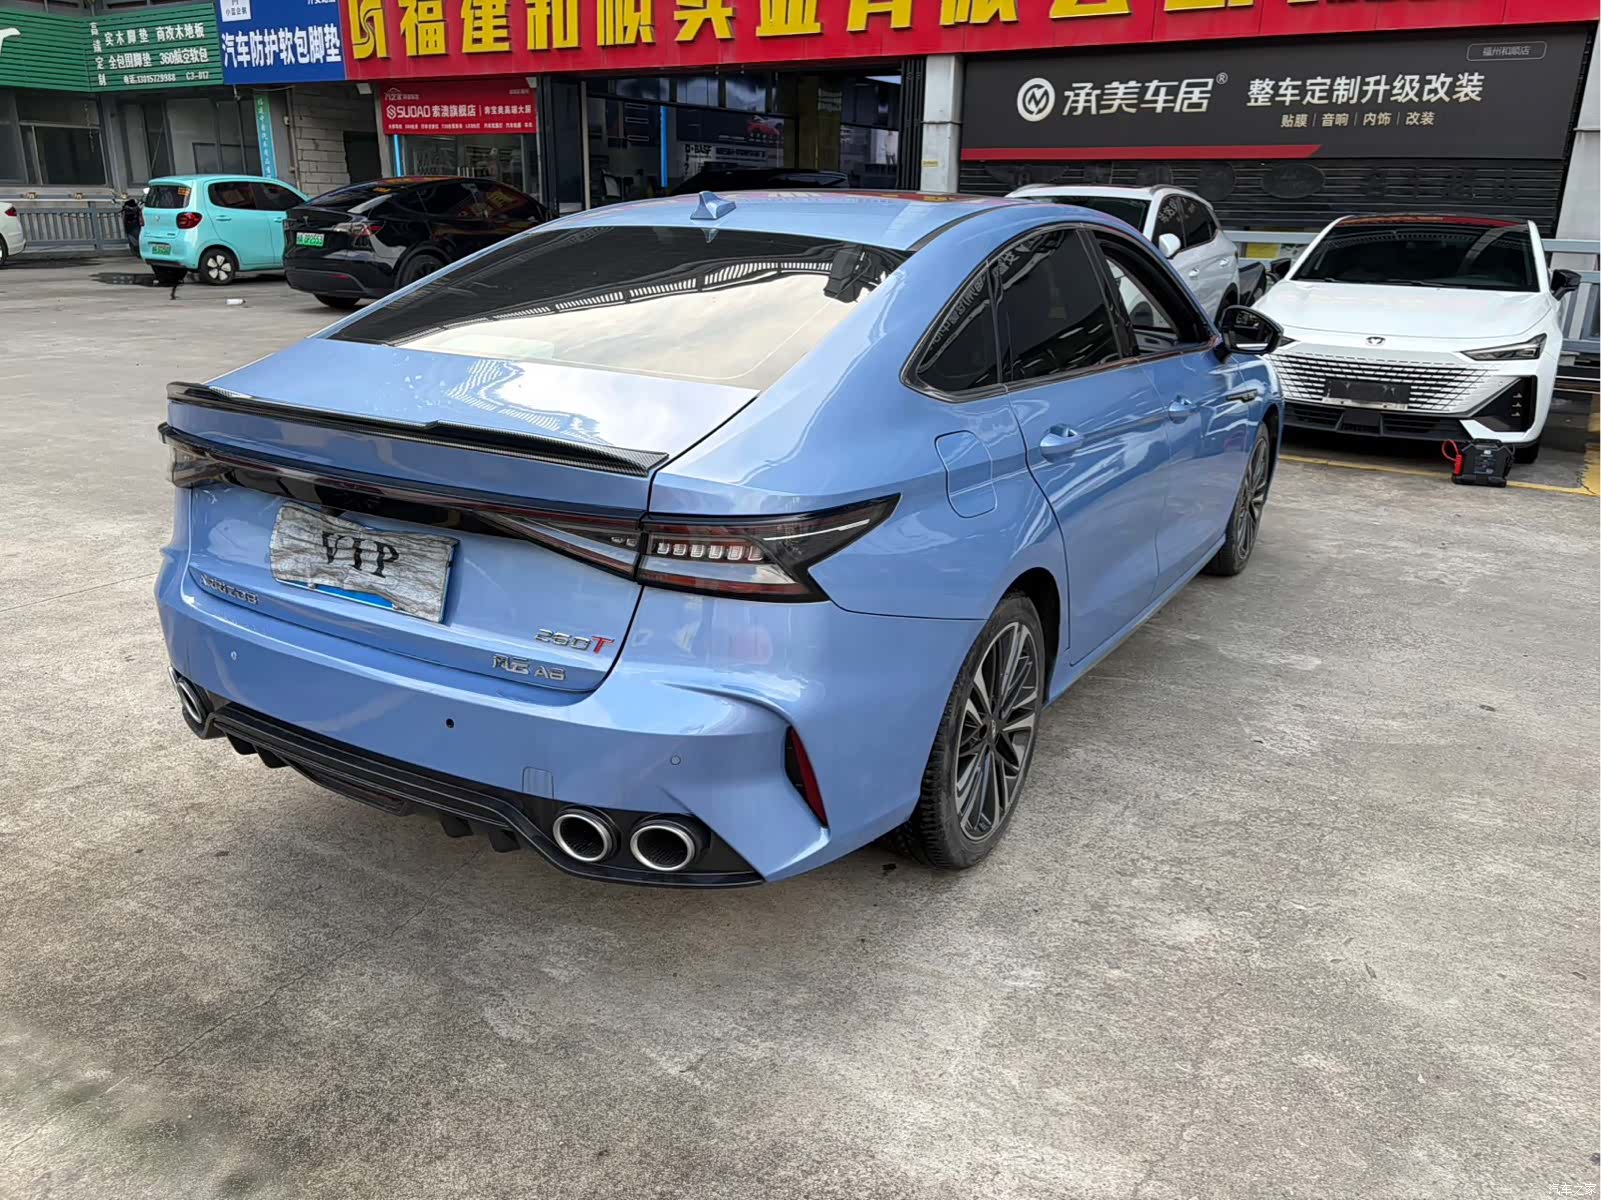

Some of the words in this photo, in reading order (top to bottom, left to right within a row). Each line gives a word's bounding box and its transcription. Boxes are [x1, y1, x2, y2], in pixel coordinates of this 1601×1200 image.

[108, 51, 153, 70] 全包围脚垫
[221, 23, 342, 68] 汽车防护软包脚垫
[1482, 45, 1530, 57] 福州和顺店
[1062, 78, 1214, 116] 承美车居
[1246, 71, 1485, 107] 整车定制升级改装
[1280, 113, 1308, 128] 贴膜
[1321, 112, 1349, 127] 音响
[1362, 112, 1392, 127] 内饰
[1405, 111, 1435, 126] 改装
[321, 530, 399, 579] VIP
